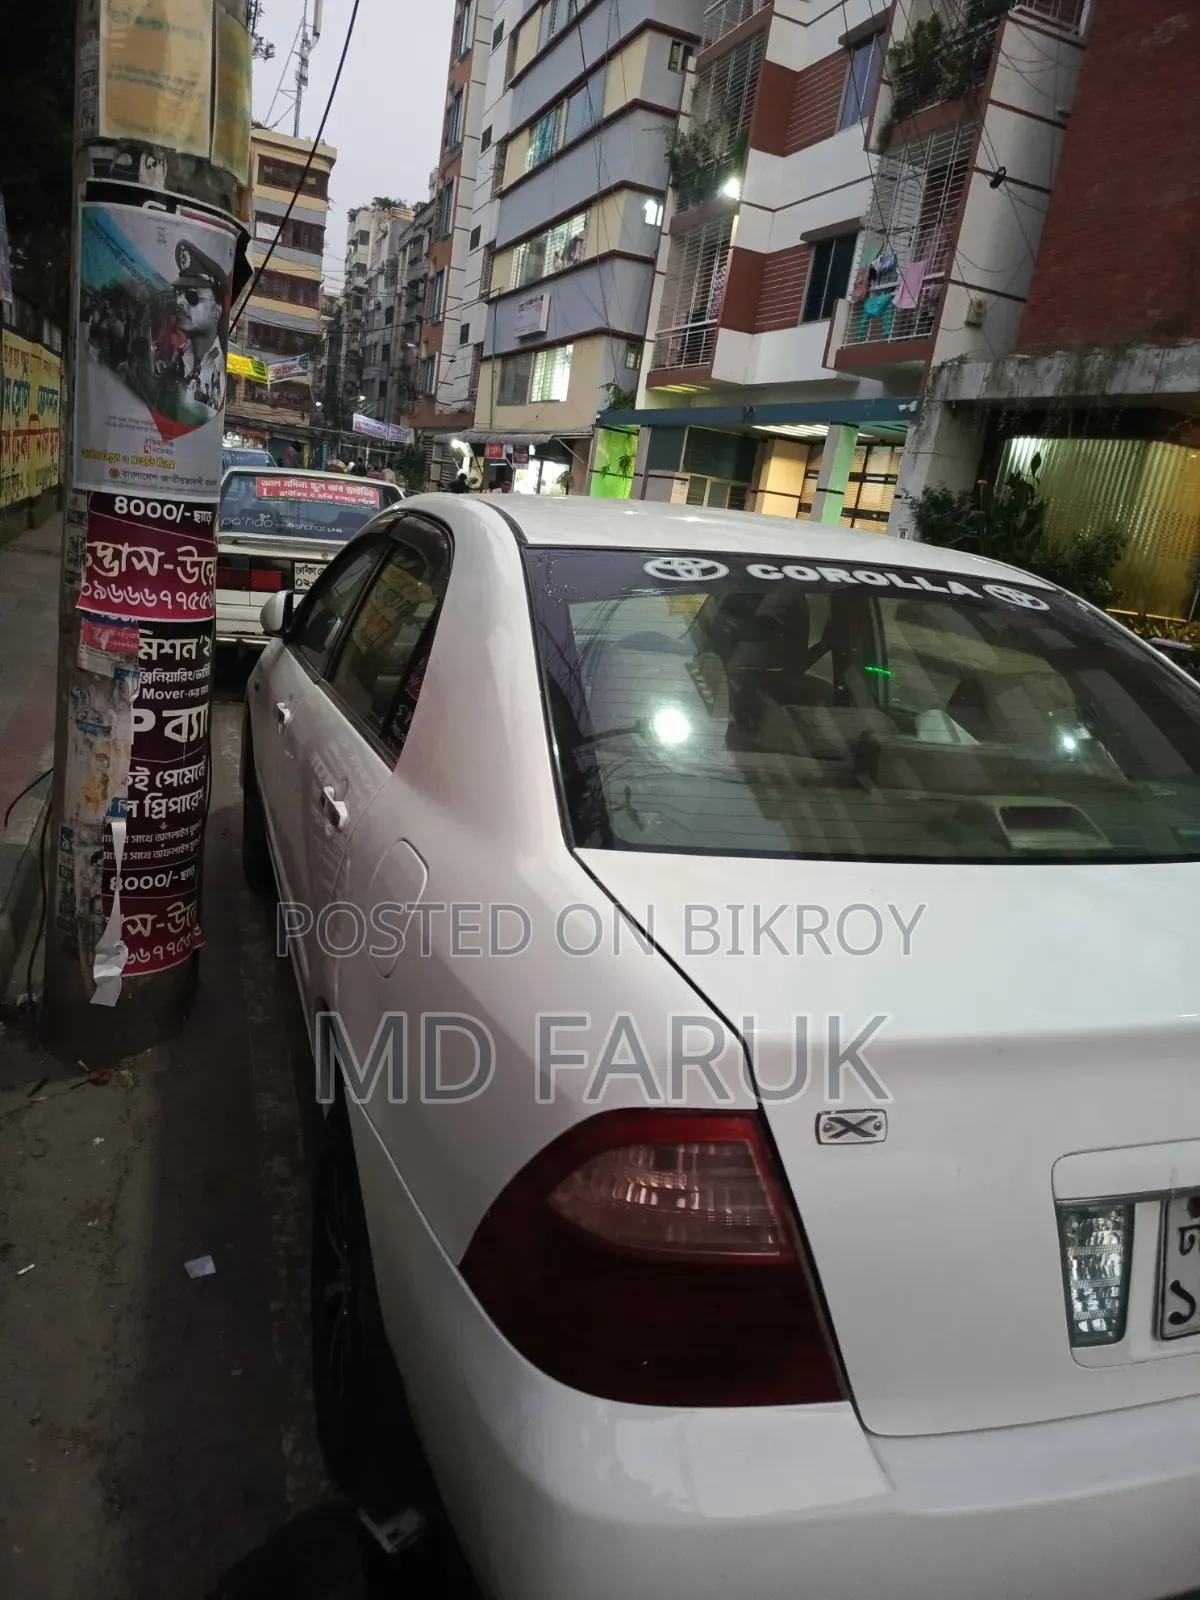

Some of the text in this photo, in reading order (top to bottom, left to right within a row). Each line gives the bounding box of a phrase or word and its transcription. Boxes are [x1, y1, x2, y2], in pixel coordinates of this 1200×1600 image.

[145, 445, 151, 454] ৭
[121, 469, 158, 482] বাংলাদেশ
[160, 474, 204, 486] জাতীয়তাবাদী
[283, 478, 308, 489] মদিনা
[310, 482, 326, 493] স্কুল
[193, 510, 213, 525] ছাড়ে
[295, 563, 318, 576] ঢাকা
[295, 577, 316, 588] ০২-
[746, 563, 984, 599] COROLLA
[131, 701, 210, 743] P ব্যা
[131, 833, 153, 844] সাথে
[154, 828, 189, 842] অনলাইন
[129, 851, 151, 860] সাথে
[153, 843, 189, 858] অফলাইন
